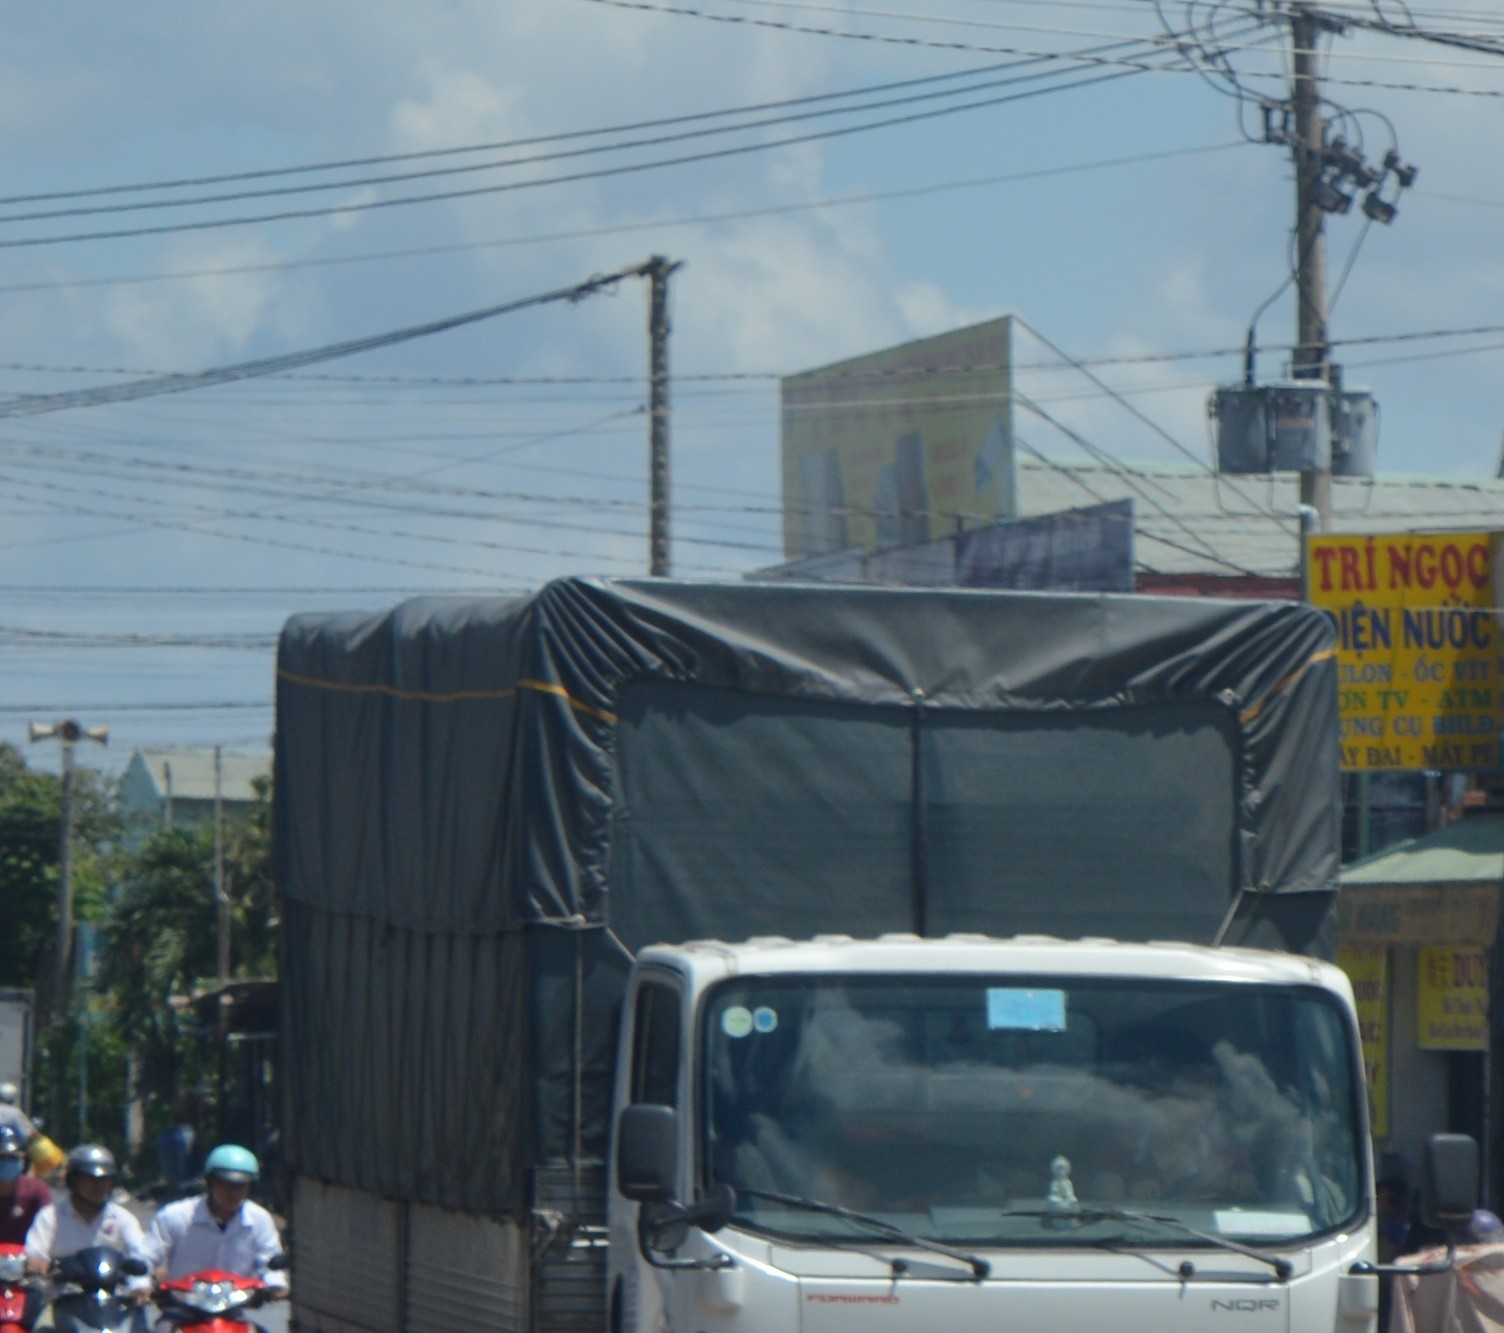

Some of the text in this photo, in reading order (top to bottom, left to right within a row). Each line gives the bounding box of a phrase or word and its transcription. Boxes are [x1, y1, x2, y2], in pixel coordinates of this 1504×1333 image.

[1314, 536, 1490, 601] TRÍ NGỌC
[1211, 1298, 1281, 1312] NQR
